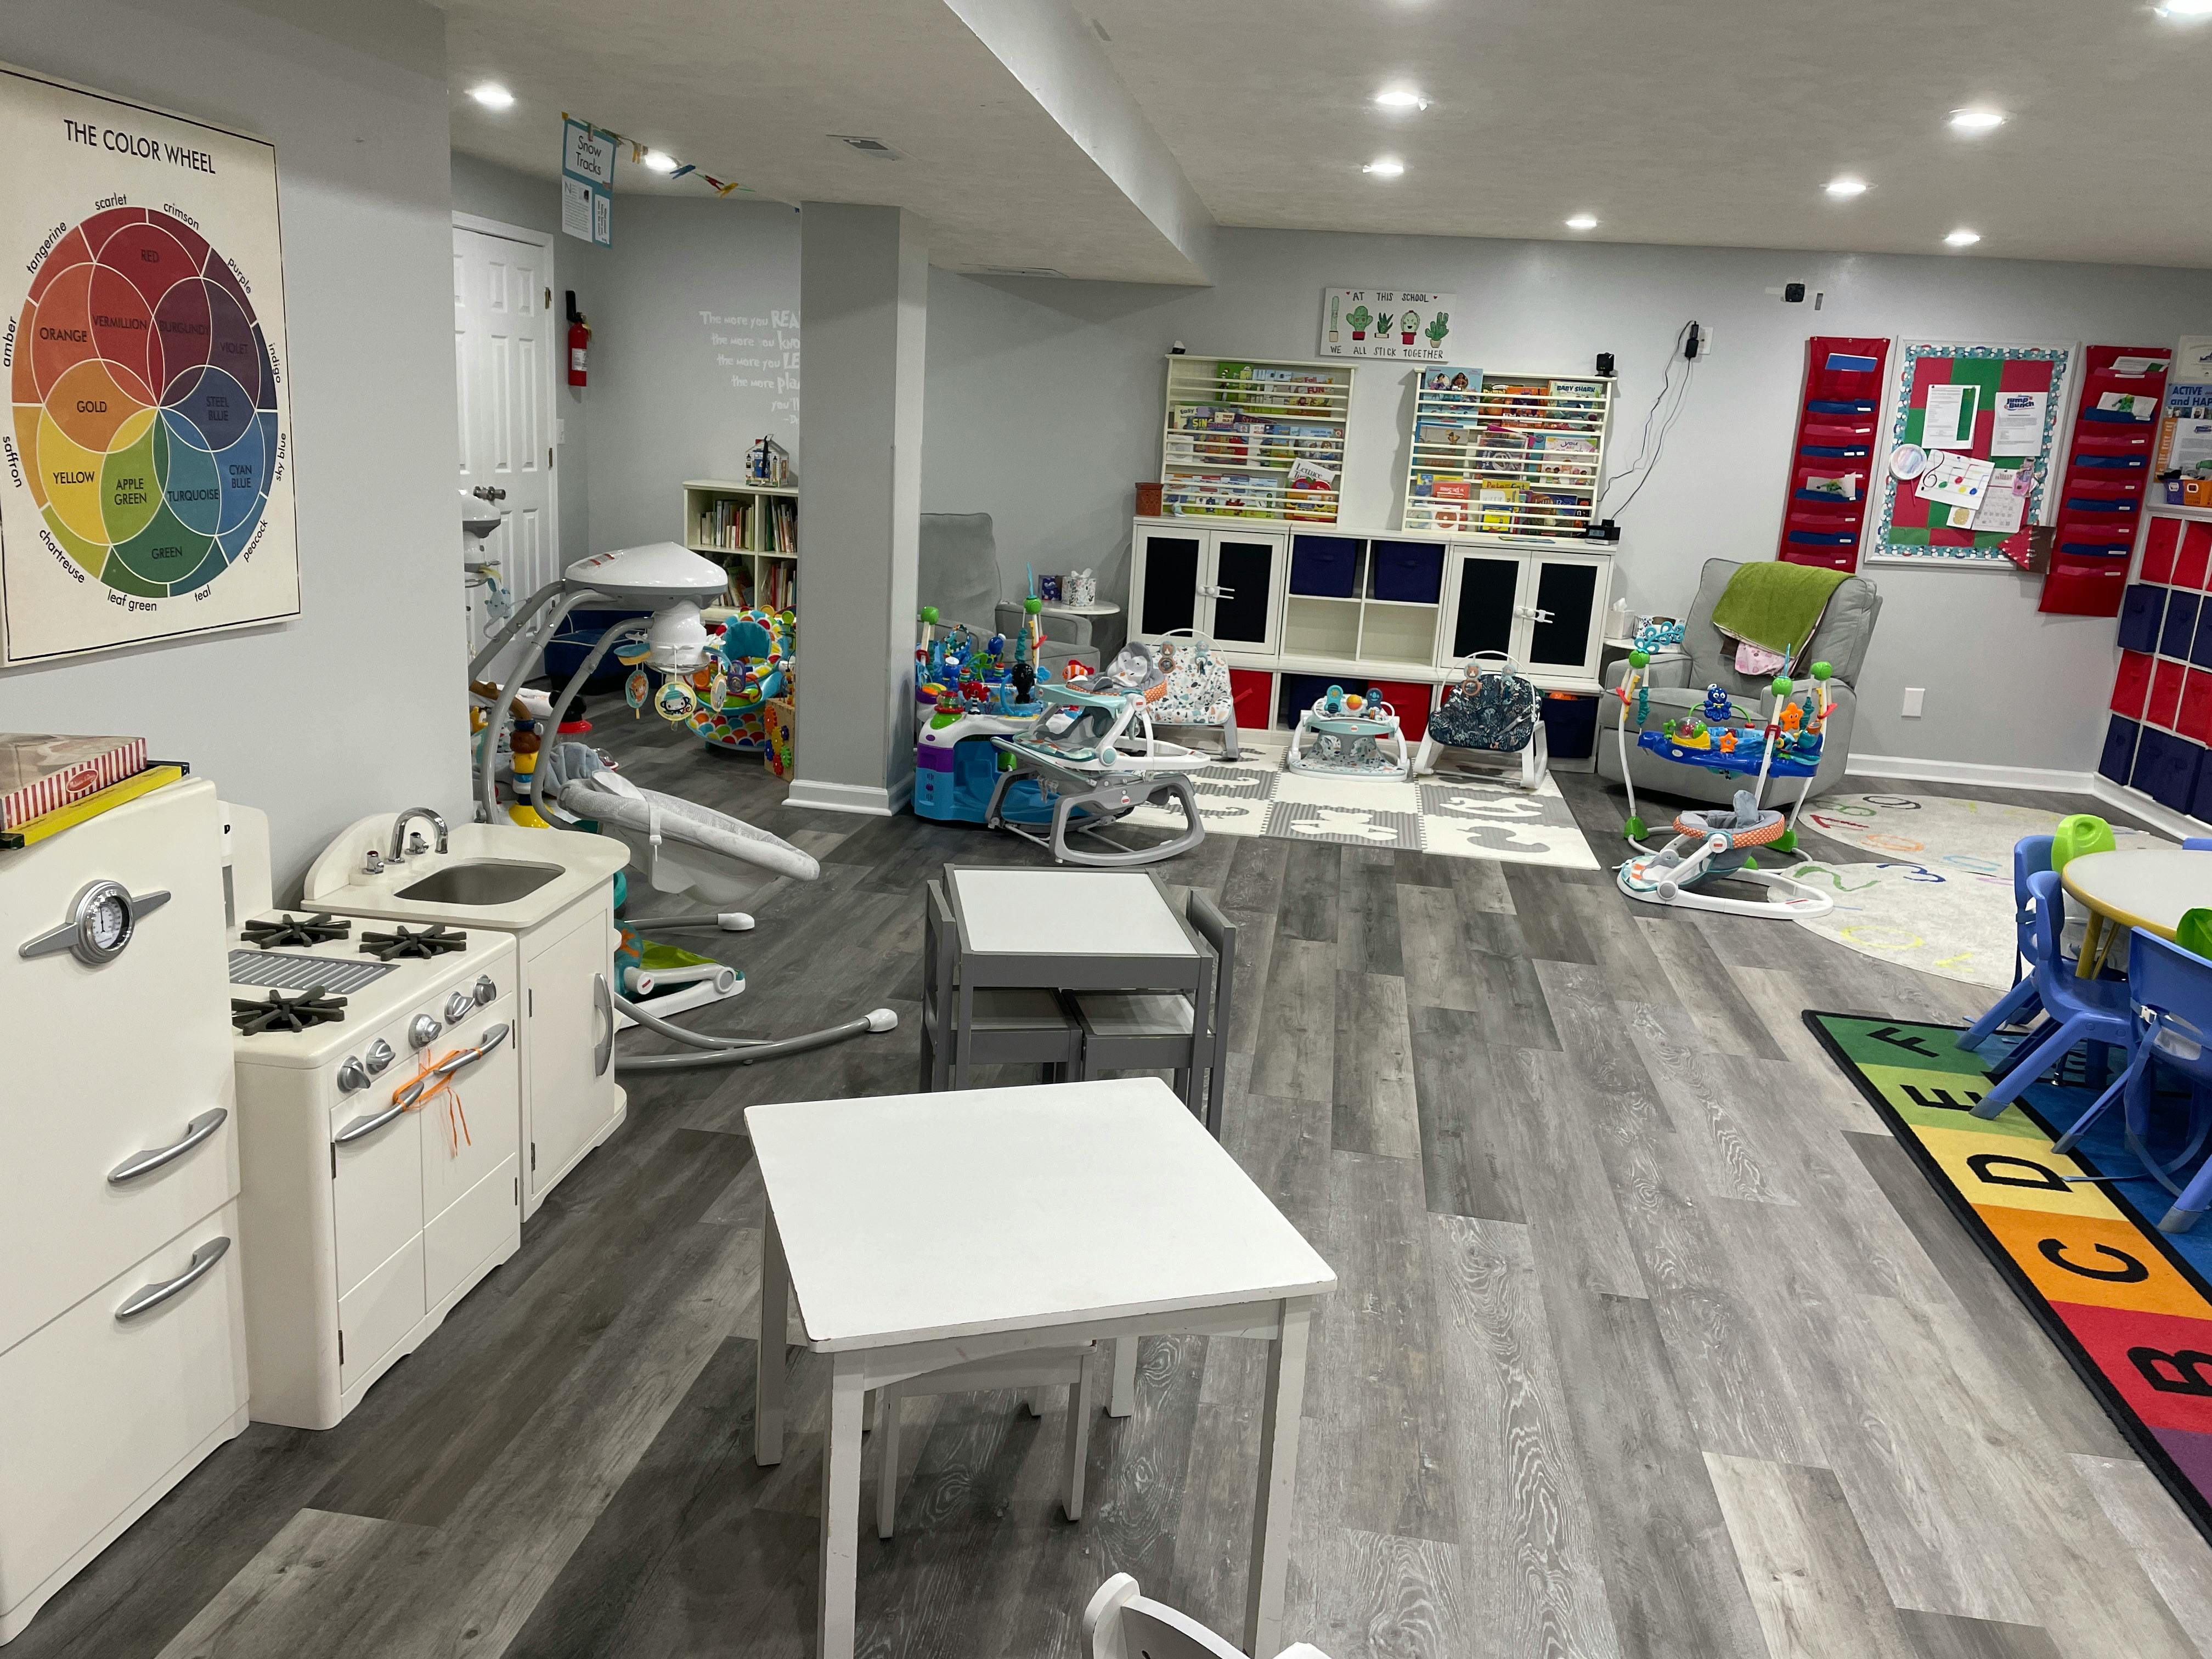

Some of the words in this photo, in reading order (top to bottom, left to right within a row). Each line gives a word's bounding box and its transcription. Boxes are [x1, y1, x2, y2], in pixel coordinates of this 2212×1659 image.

[63, 119, 98, 147] THE
[103, 129, 161, 161] COLOR
[164, 143, 216, 174] WHEEL
[578, 136, 602, 157] Snow
[575, 151, 601, 176] Tracks
[94, 193, 127, 211] scarlet
[163, 201, 200, 230] crimson
[26, 221, 67, 274] tangerine
[140, 249, 159, 263] RED
[227, 257, 252, 295] purple
[1352, 292, 1365, 301] AT
[1376, 292, 1393, 301] THIS
[1401, 293, 1429, 302] SCHOOL
[92, 315, 147, 330] VERMILLION
[159, 320, 211, 336] BURGUNDY
[751, 317, 768, 329] you
[771, 310, 800, 329] REA
[2, 315, 17, 368] amber
[40, 328, 87, 343] ORANGE
[710, 332, 727, 346] the
[219, 342, 249, 355] VIOLET
[1330, 346, 1342, 354] WE
[1353, 346, 1367, 355] ALL
[1373, 347, 1396, 357] STICK
[1403, 348, 1443, 359] TOGETHER
[268, 342, 281, 383] indigo
[717, 353, 733, 366] the
[763, 358, 780, 371] you
[731, 375, 748, 387] the
[2172, 386, 2203, 395] ACTIVE
[76, 400, 108, 413] GOLD
[205, 397, 230, 409] STEEL
[2171, 396, 2190, 405] and
[208, 409, 229, 421] BLUE
[277, 432, 287, 459] blue
[3, 436, 22, 488] saffron
[229, 464, 252, 476] CYAN
[53, 471, 95, 485] YELLOW
[275, 460, 285, 482] sky
[115, 478, 144, 492] APPLE
[231, 477, 252, 489] BLUE
[114, 492, 147, 505] GREEN
[167, 489, 219, 501] TURQUOISE
[242, 519, 268, 562] peacock
[38, 529, 85, 584] chartreuse
[151, 546, 183, 560] GREEN
[108, 589, 127, 607] leaf
[128, 598, 157, 612] green
[194, 585, 212, 602] teal
[1867, 1025, 1940, 1058] F
[1900, 1083, 1984, 1113] E
[1967, 1153, 2074, 1193] D
[2038, 1237, 2149, 1284] C
[2126, 1346, 2212, 1397] B
